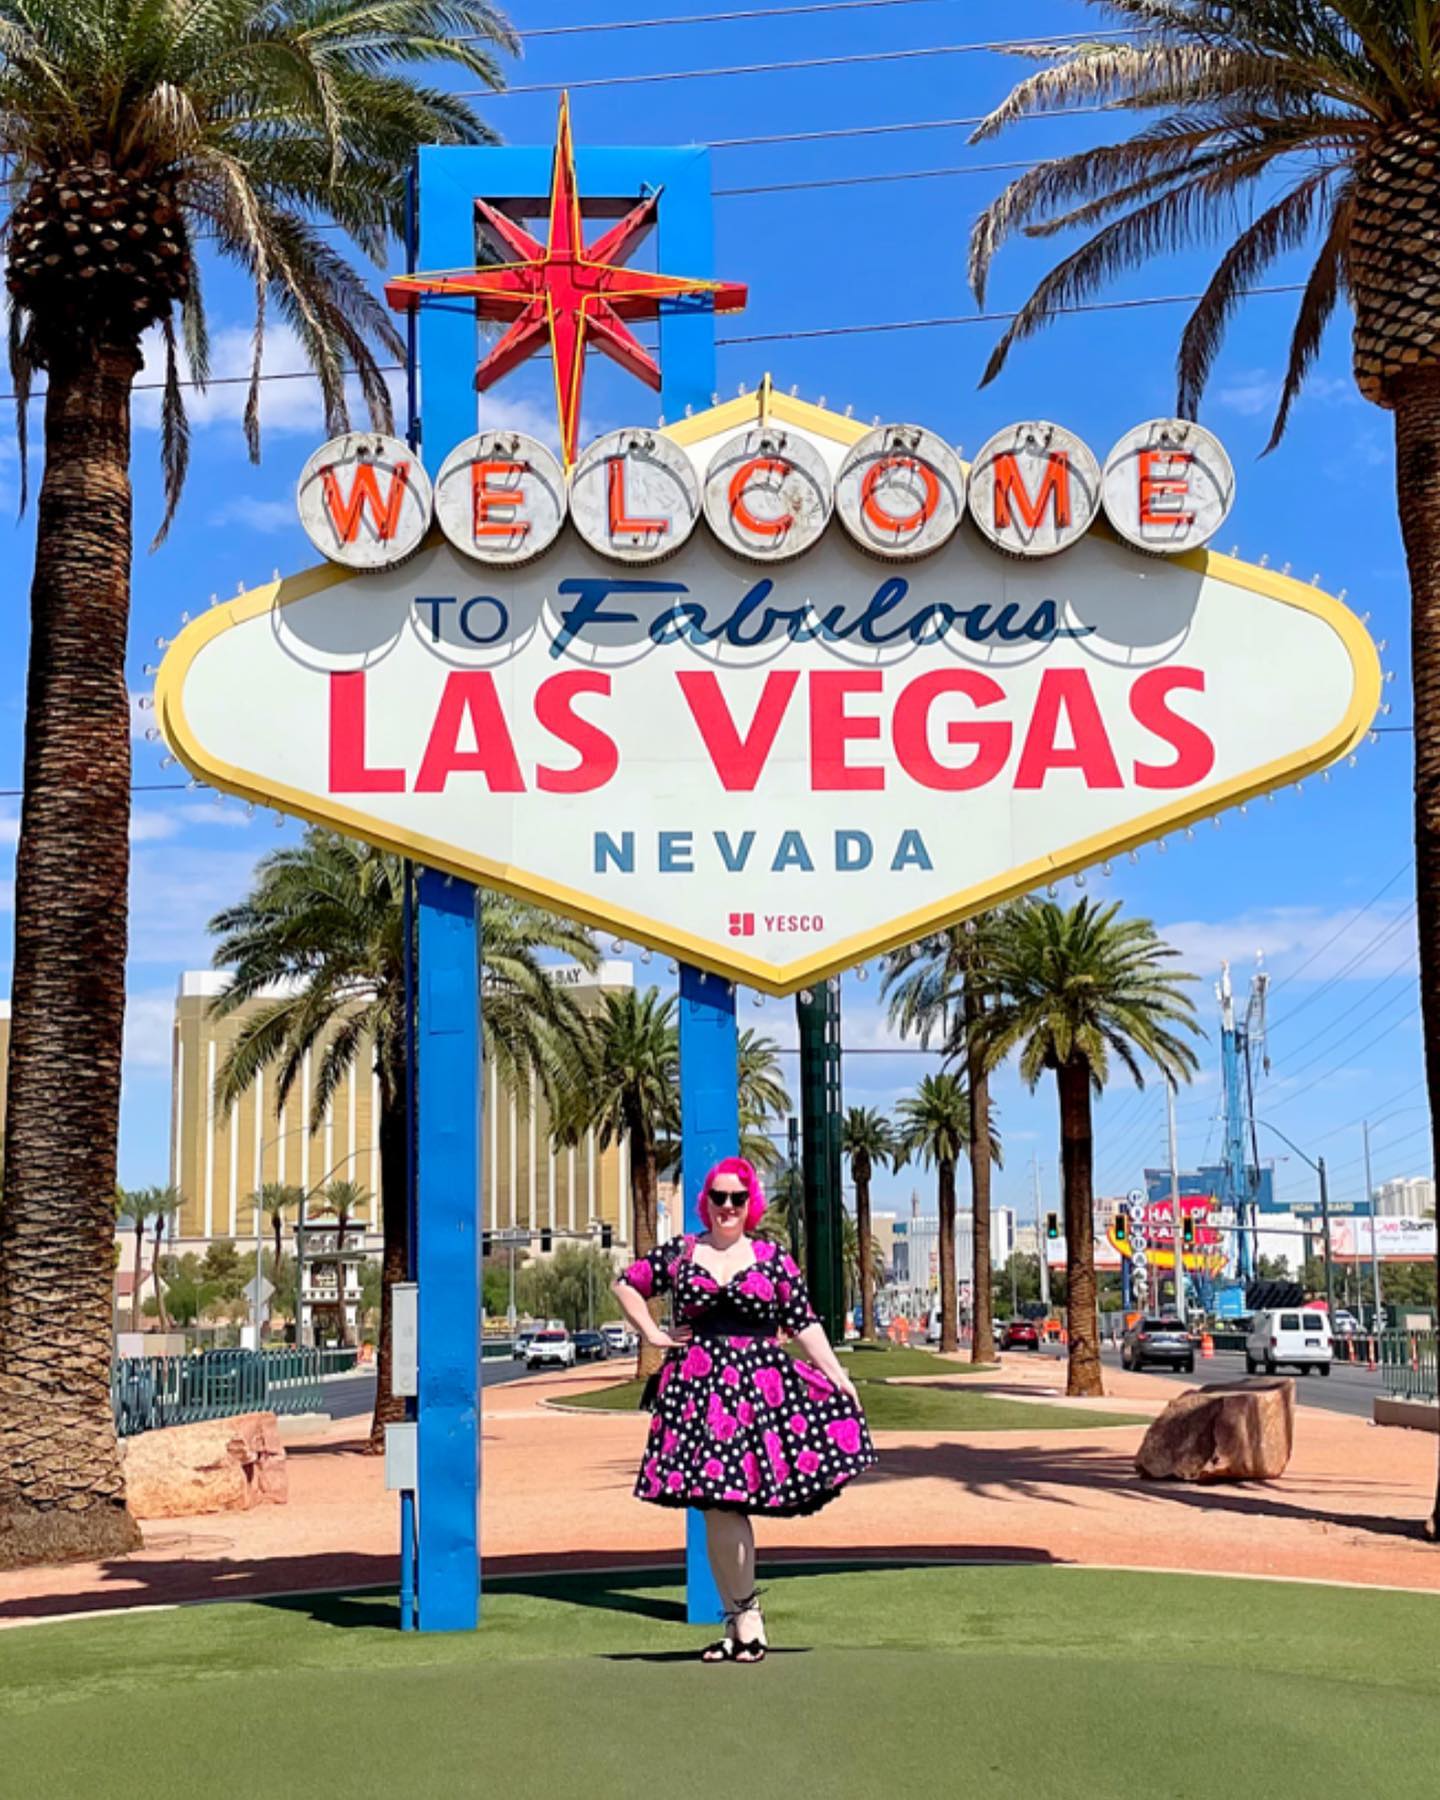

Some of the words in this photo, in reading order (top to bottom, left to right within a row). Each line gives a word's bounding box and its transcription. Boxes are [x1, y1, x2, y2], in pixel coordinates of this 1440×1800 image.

[319, 449, 1196, 543] WELCOME
[415, 596, 509, 645] TO
[548, 577, 1097, 660] Fabulous
[328, 669, 621, 795] LAS
[675, 665, 1216, 792] VEGAS
[594, 829, 934, 873] NEVADA
[764, 915, 824, 933] YESCO
